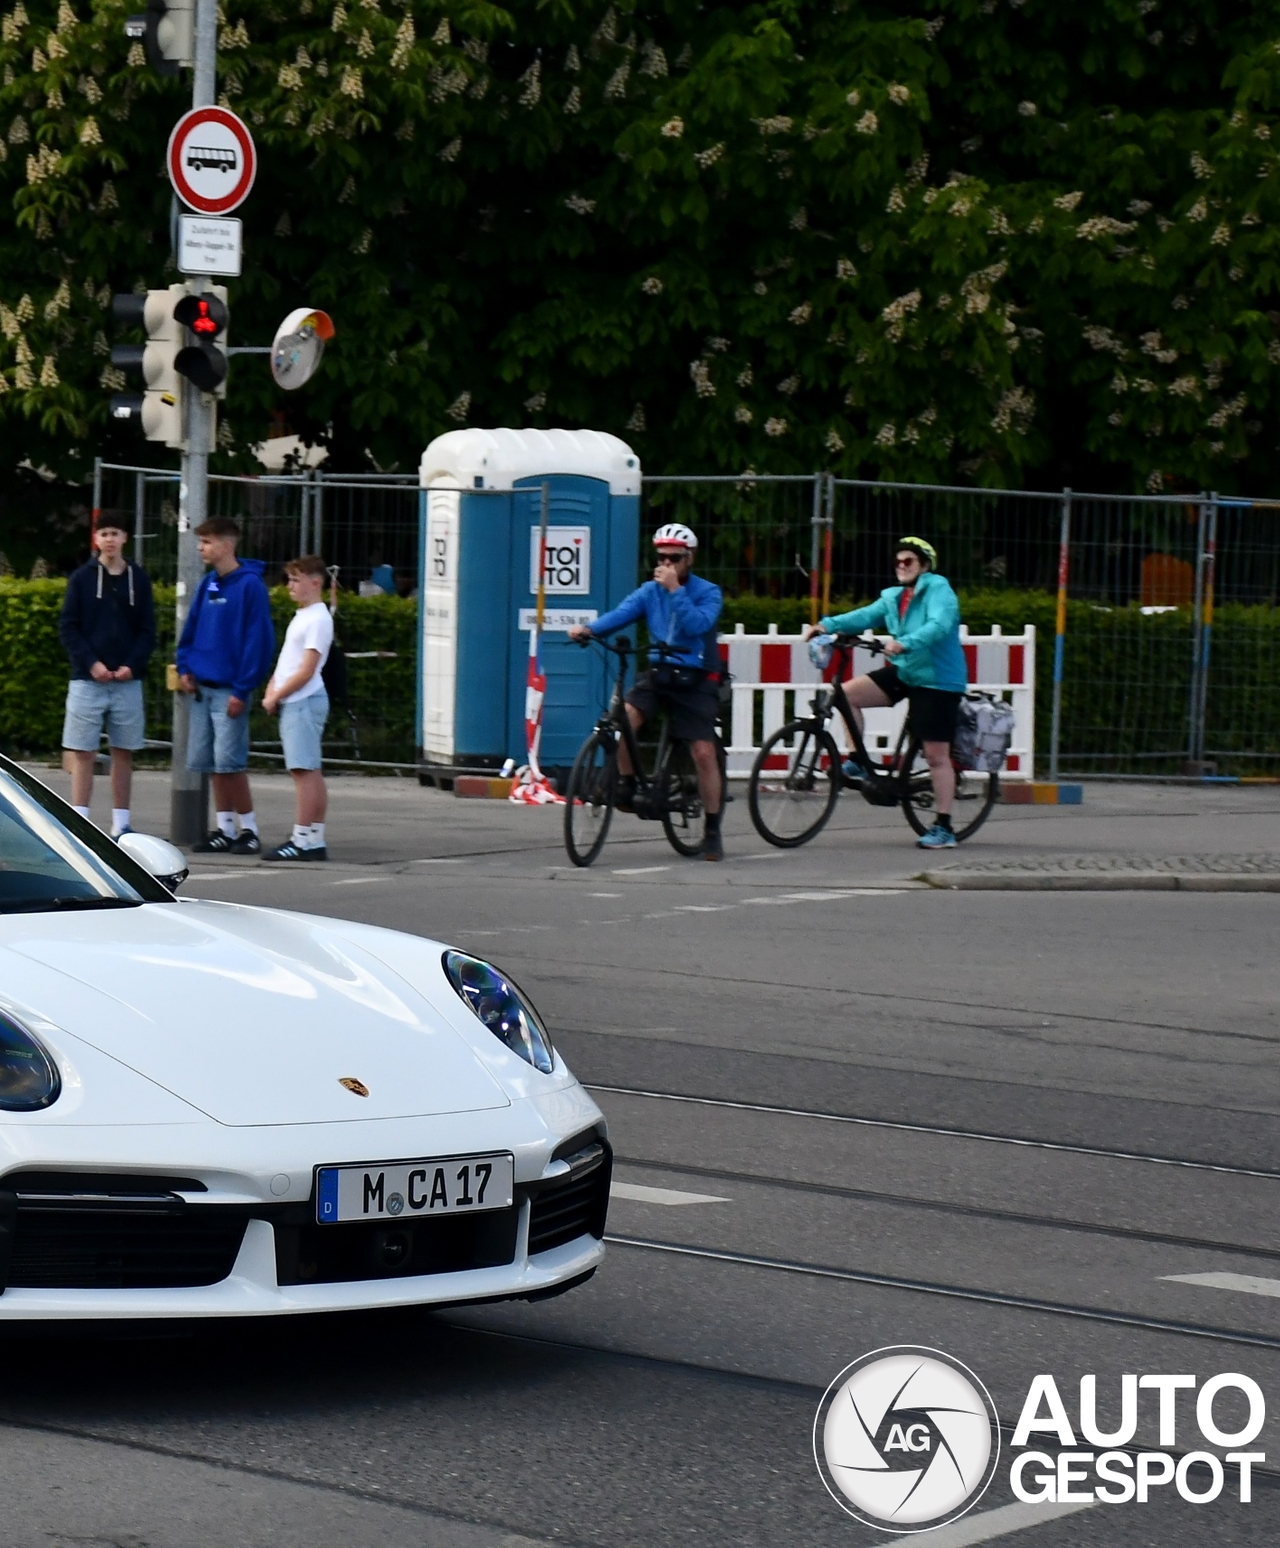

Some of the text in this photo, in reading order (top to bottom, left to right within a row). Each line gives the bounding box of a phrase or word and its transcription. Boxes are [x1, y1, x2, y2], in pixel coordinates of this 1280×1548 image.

[324, 1163, 492, 1213] D M CA 17
